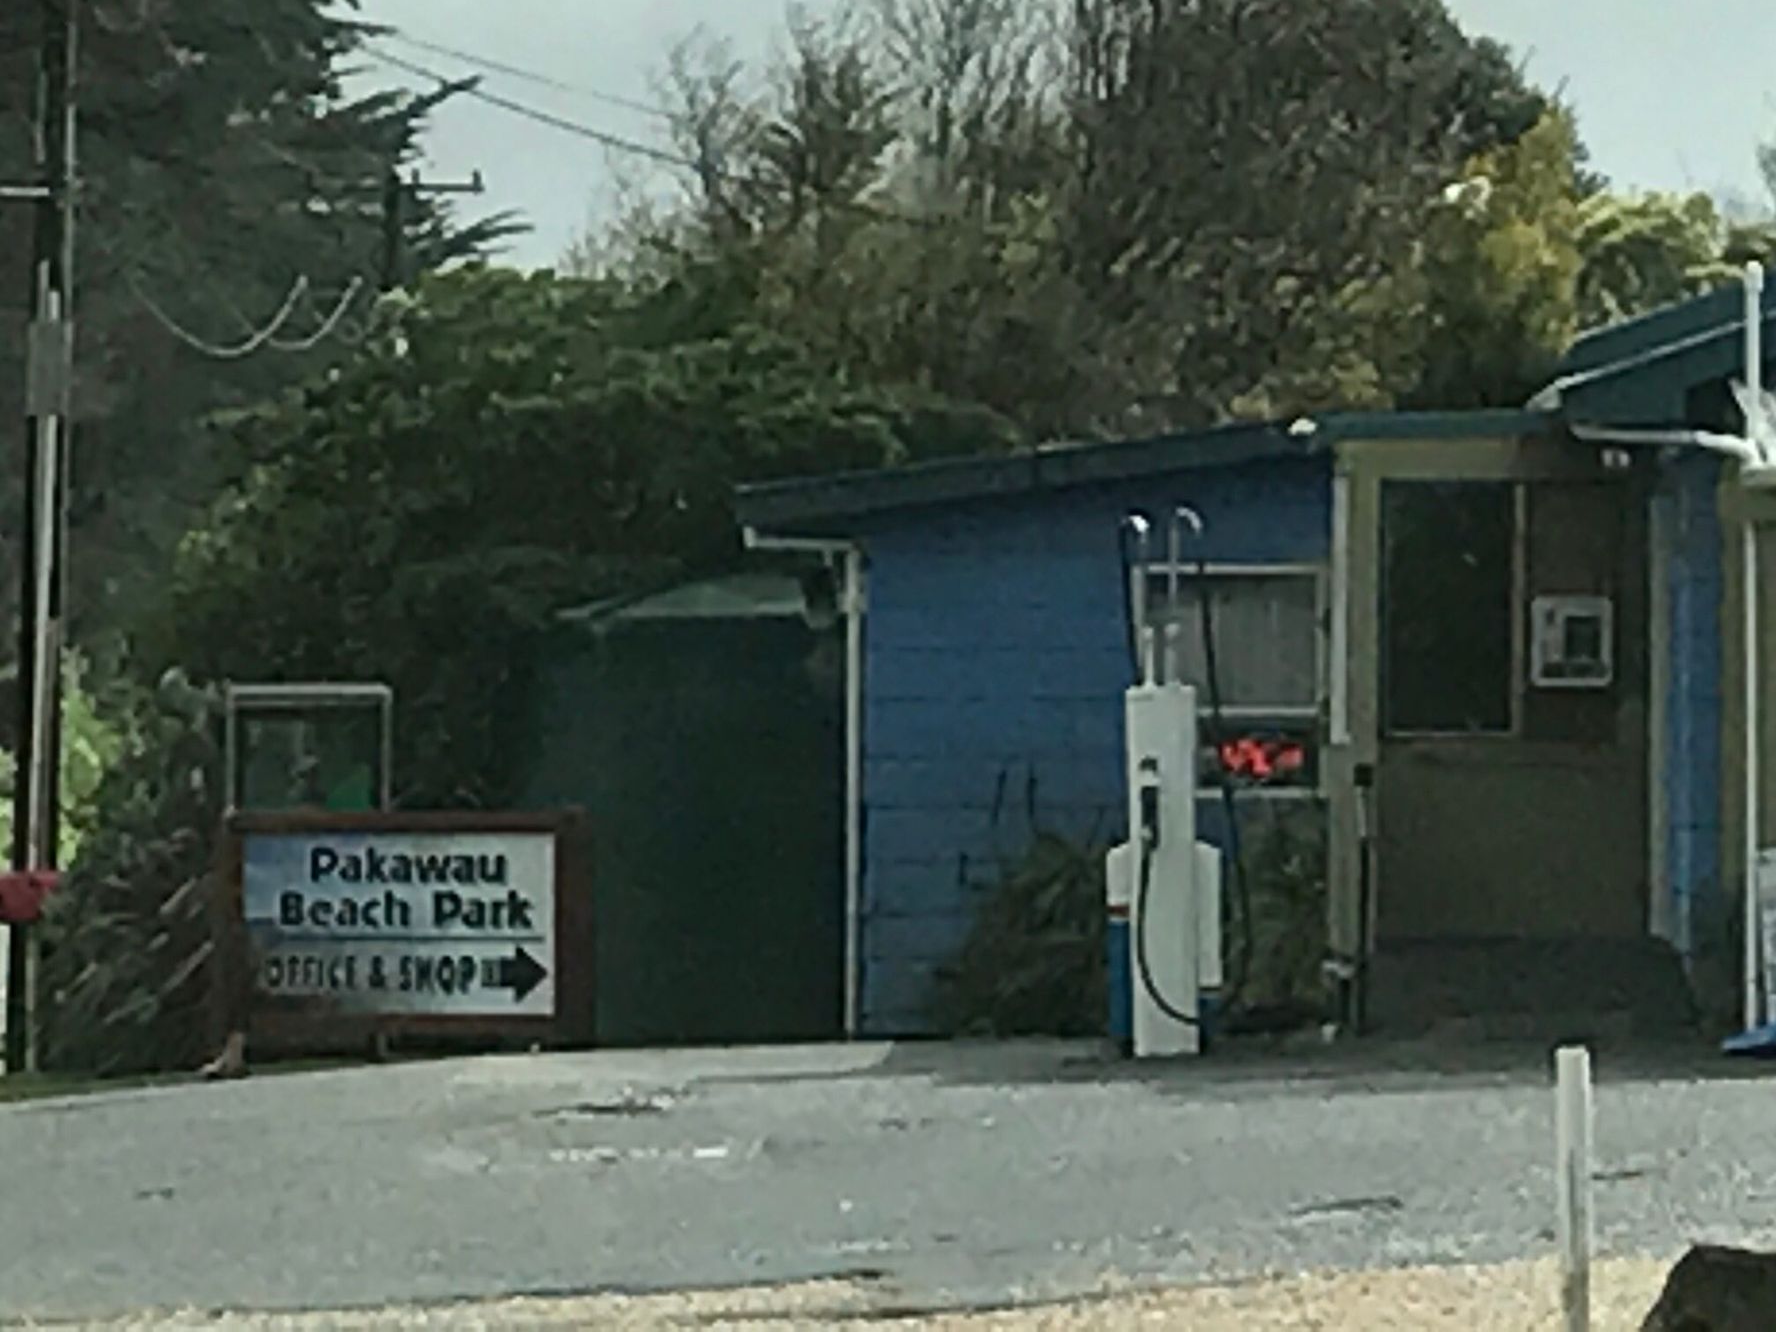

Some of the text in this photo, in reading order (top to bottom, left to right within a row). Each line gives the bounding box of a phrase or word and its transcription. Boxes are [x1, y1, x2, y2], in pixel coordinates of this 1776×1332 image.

[310, 846, 507, 884] Pakawau
[279, 889, 533, 929] Beach Park
[264, 954, 477, 994] OFFICE & SHOP
